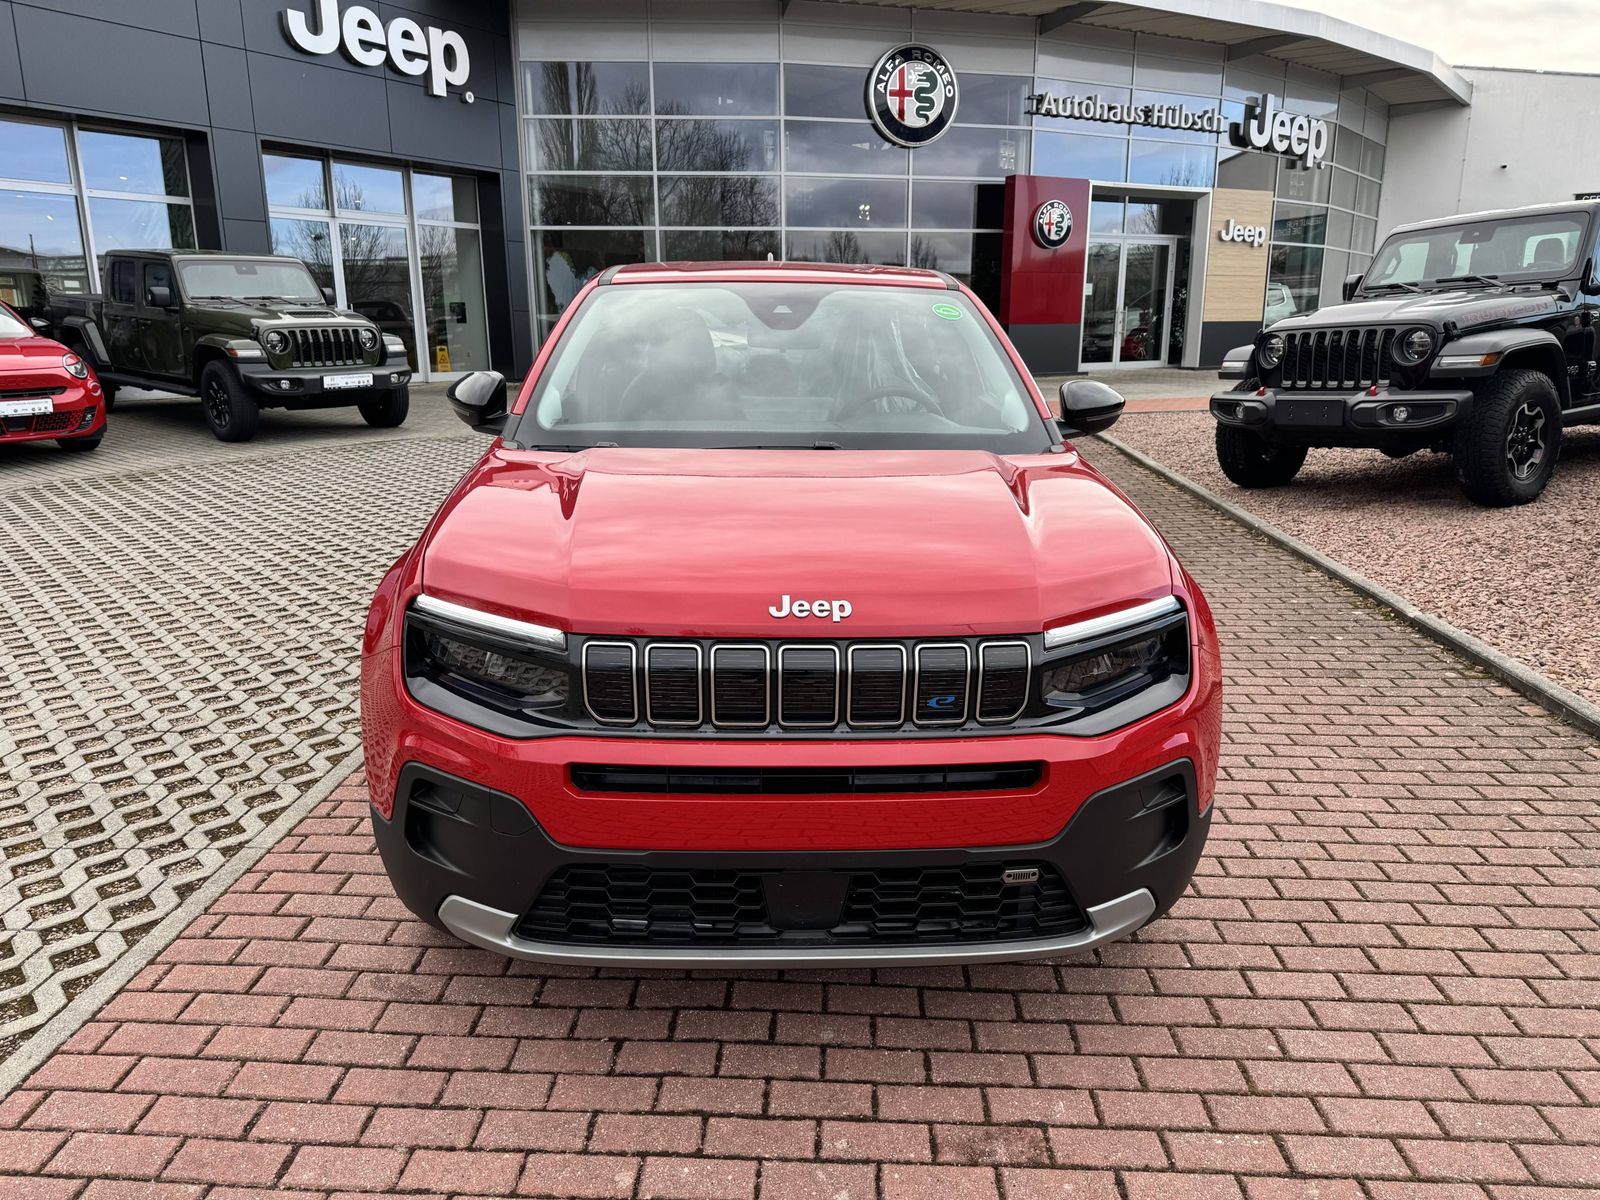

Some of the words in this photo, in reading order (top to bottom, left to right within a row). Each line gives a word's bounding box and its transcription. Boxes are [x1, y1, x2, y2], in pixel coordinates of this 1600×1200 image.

[284, 0, 470, 97] Jeep
[877, 54, 904, 94] ALFA
[911, 49, 954, 98] ROMEO
[1041, 92, 1145, 123] Autohaus
[1152, 103, 1225, 132] Hübsch
[1249, 93, 1328, 168] Jeep
[1039, 204, 1052, 225] ALFA
[1220, 218, 1266, 247] Jeep
[768, 594, 852, 622] Jeep
